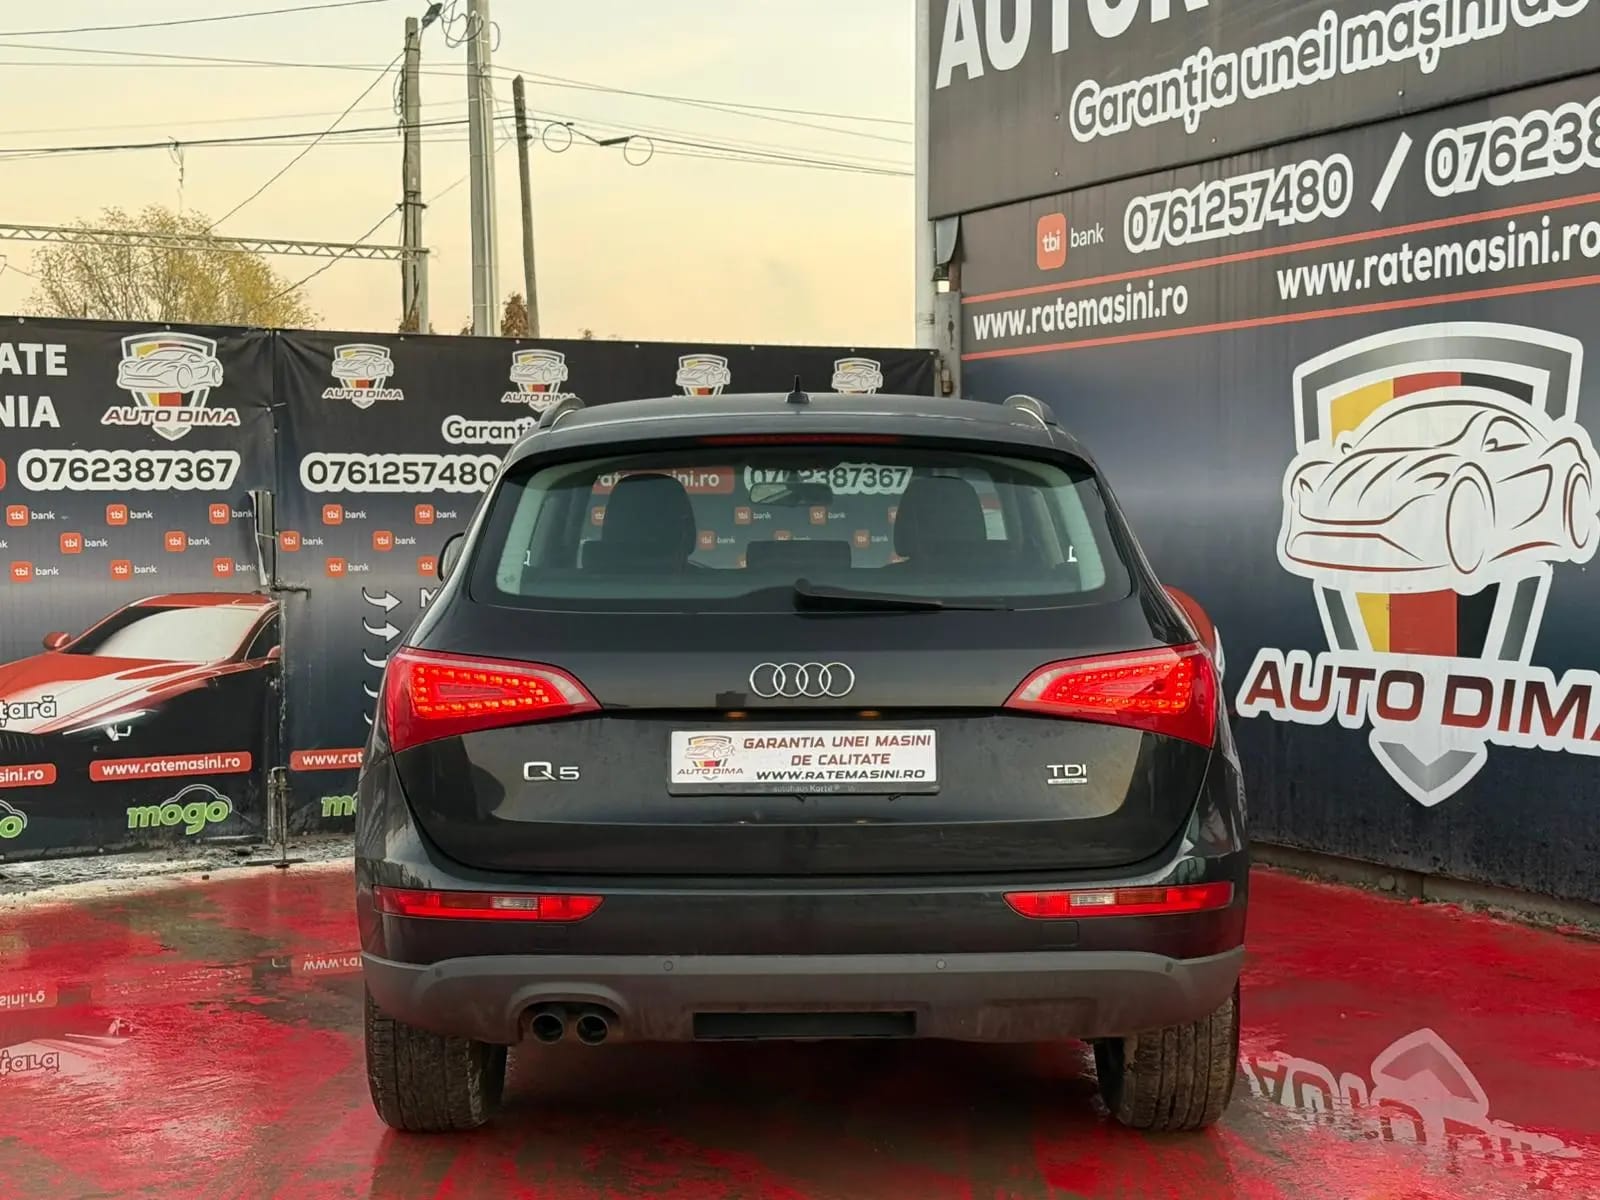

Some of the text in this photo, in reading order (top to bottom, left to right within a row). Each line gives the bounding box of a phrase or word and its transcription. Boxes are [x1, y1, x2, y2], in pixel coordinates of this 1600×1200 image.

[1244, 17, 1334, 92] unei
[1127, 161, 1349, 248] 0761257480
[1041, 222, 1105, 253] tbi bank
[1276, 214, 1600, 300] www.ratemasini.ro
[972, 279, 1189, 341] www.ratemasini.ro
[324, 390, 403, 400] AUTO DIMA
[503, 393, 540, 402] AUTO
[104, 409, 238, 424] AUTO DIMA
[26, 457, 233, 483] 0762387367
[307, 459, 498, 485] 0761257480
[10, 509, 56, 520] tbi bank
[110, 509, 153, 519] tbi bank
[212, 508, 254, 518] tbi bank
[327, 509, 367, 519] tbi bank
[419, 510, 457, 519] tbi bank
[64, 537, 109, 548] tbi bank
[169, 536, 211, 546] tbi bank
[284, 535, 324, 546] tbi bank
[377, 535, 417, 546] tbi bank
[14, 565, 60, 577] tbi bank
[114, 563, 157, 575] tbi bank
[216, 561, 257, 572] tbi bank
[330, 562, 370, 573] tbi bank
[1244, 660, 1600, 742] AUTO DIM
[743, 735, 931, 749] GARANTIA UNEI MASINI
[791, 753, 892, 766] DE CALITATE
[102, 756, 241, 776] www.ratemasini.ro
[523, 761, 580, 780] Q5
[677, 766, 744, 776] AUTO DIMA
[1046, 763, 1087, 777] TDI
[756, 769, 926, 780] WWW.RATEMASINI.RO
[127, 800, 229, 835] mogo
